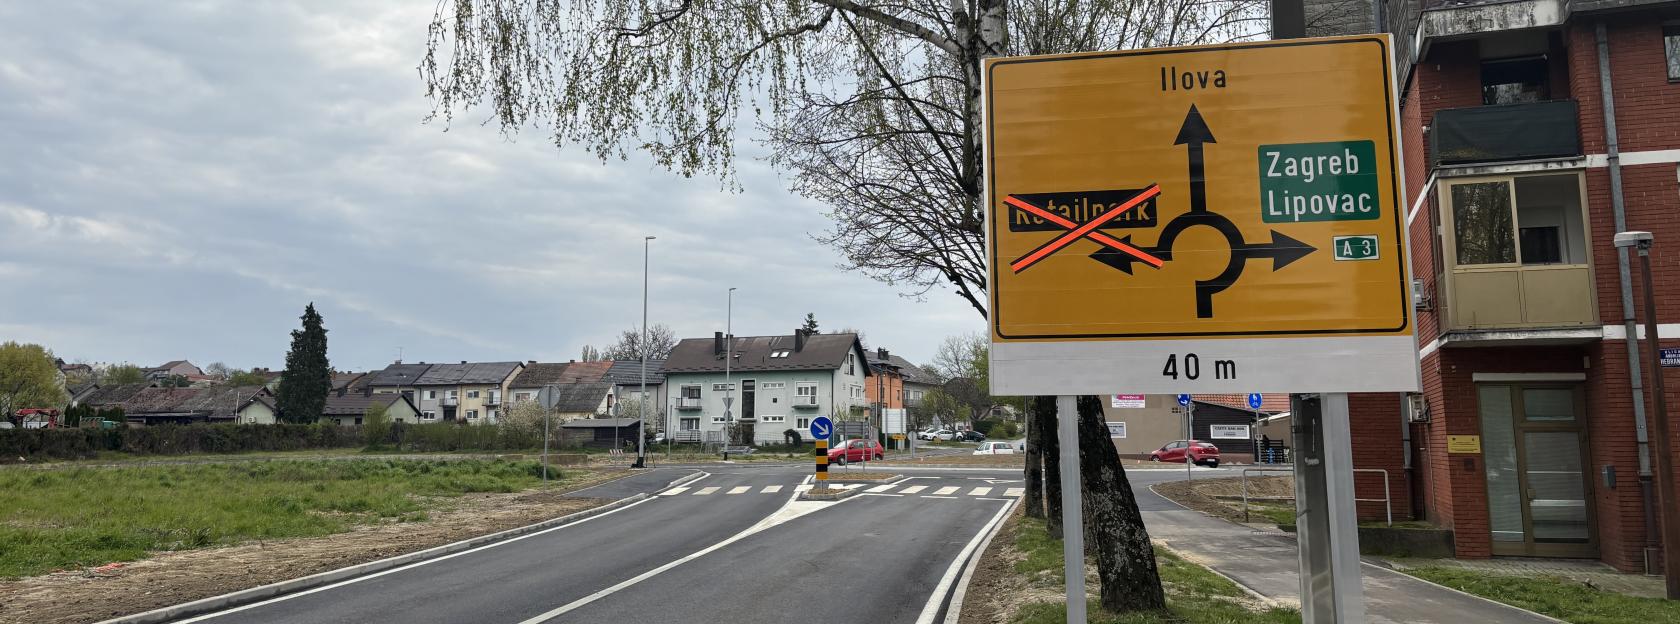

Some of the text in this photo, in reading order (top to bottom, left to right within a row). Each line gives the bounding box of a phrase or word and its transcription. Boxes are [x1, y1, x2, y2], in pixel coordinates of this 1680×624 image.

[1161, 66, 1226, 91] Ilova
[1266, 148, 1359, 182] Zagreb
[1268, 190, 1371, 221] Lipovac
[1343, 239, 1371, 256] A 3
[1163, 353, 1236, 380] 40 m
